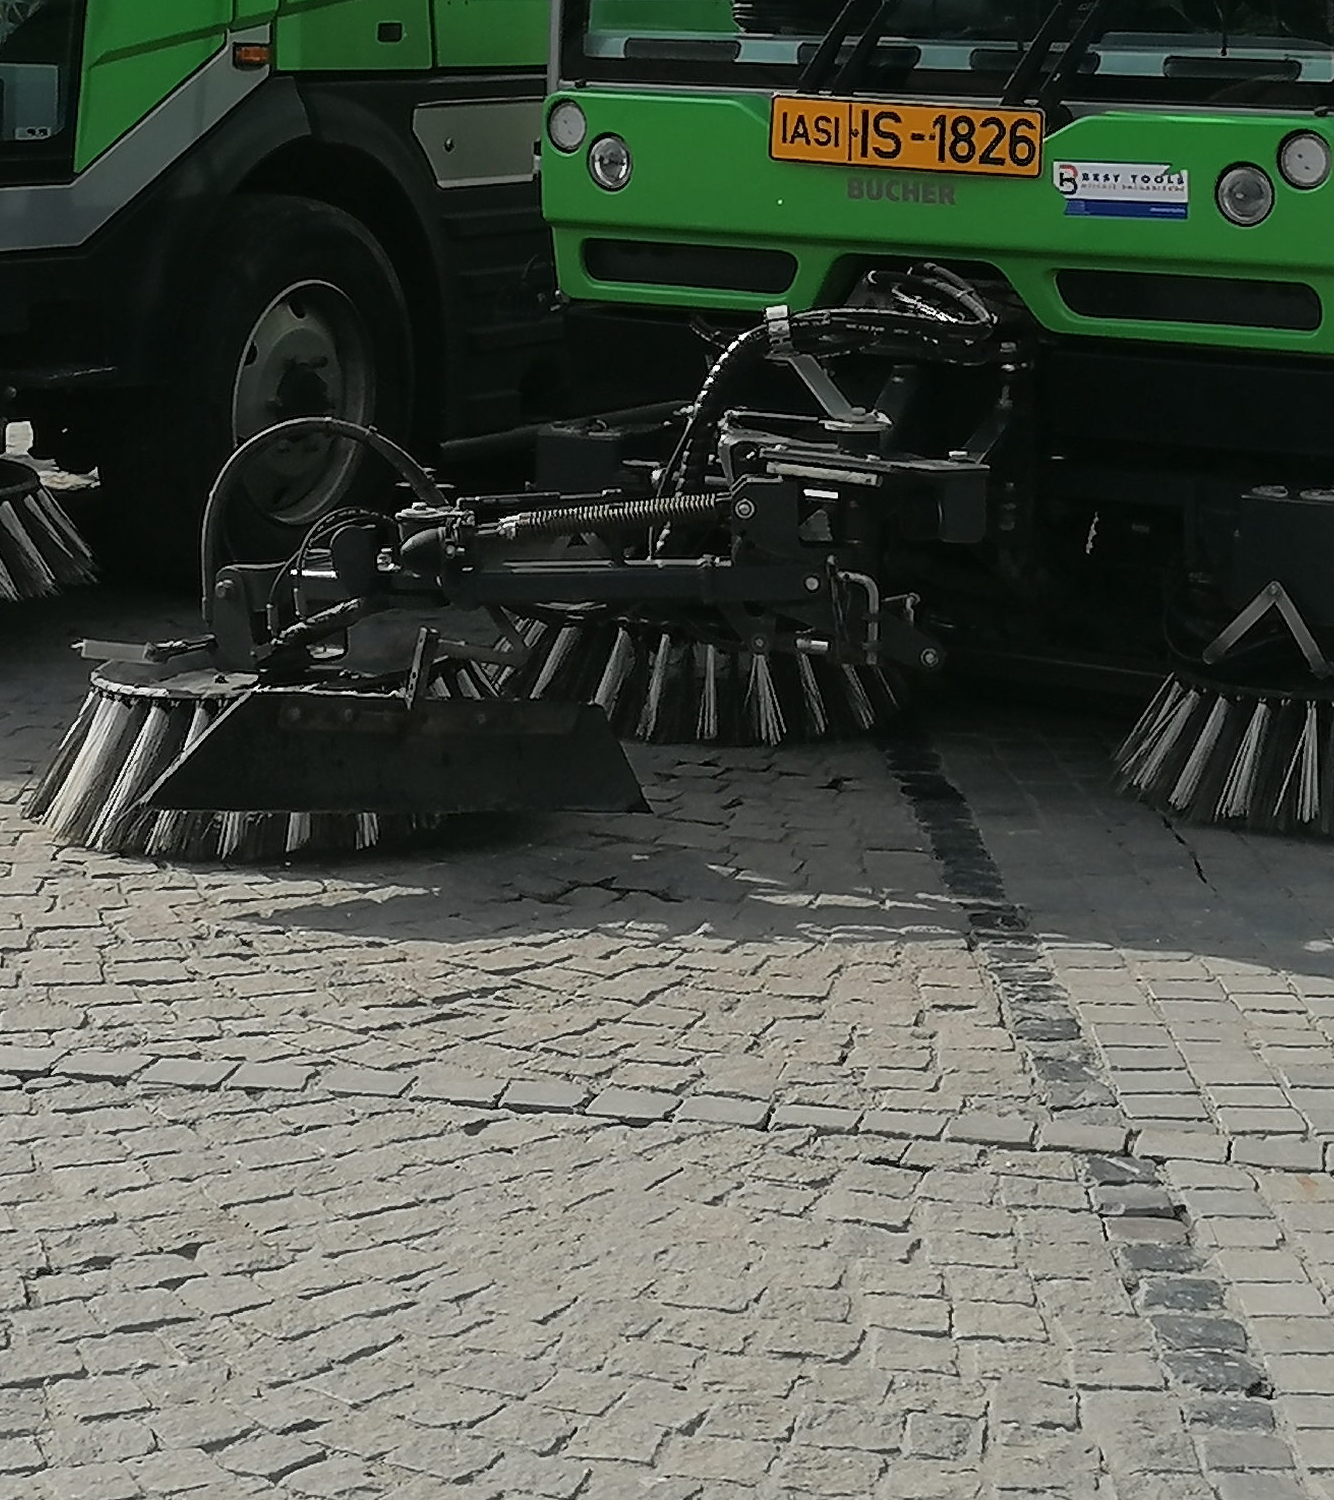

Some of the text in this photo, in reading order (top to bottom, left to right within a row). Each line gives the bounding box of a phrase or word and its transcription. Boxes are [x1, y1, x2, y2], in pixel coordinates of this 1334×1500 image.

[781, 111, 840, 149] IASI
[1081, 172, 1120, 183] BEST
[847, 178, 956, 205] BUCHER
